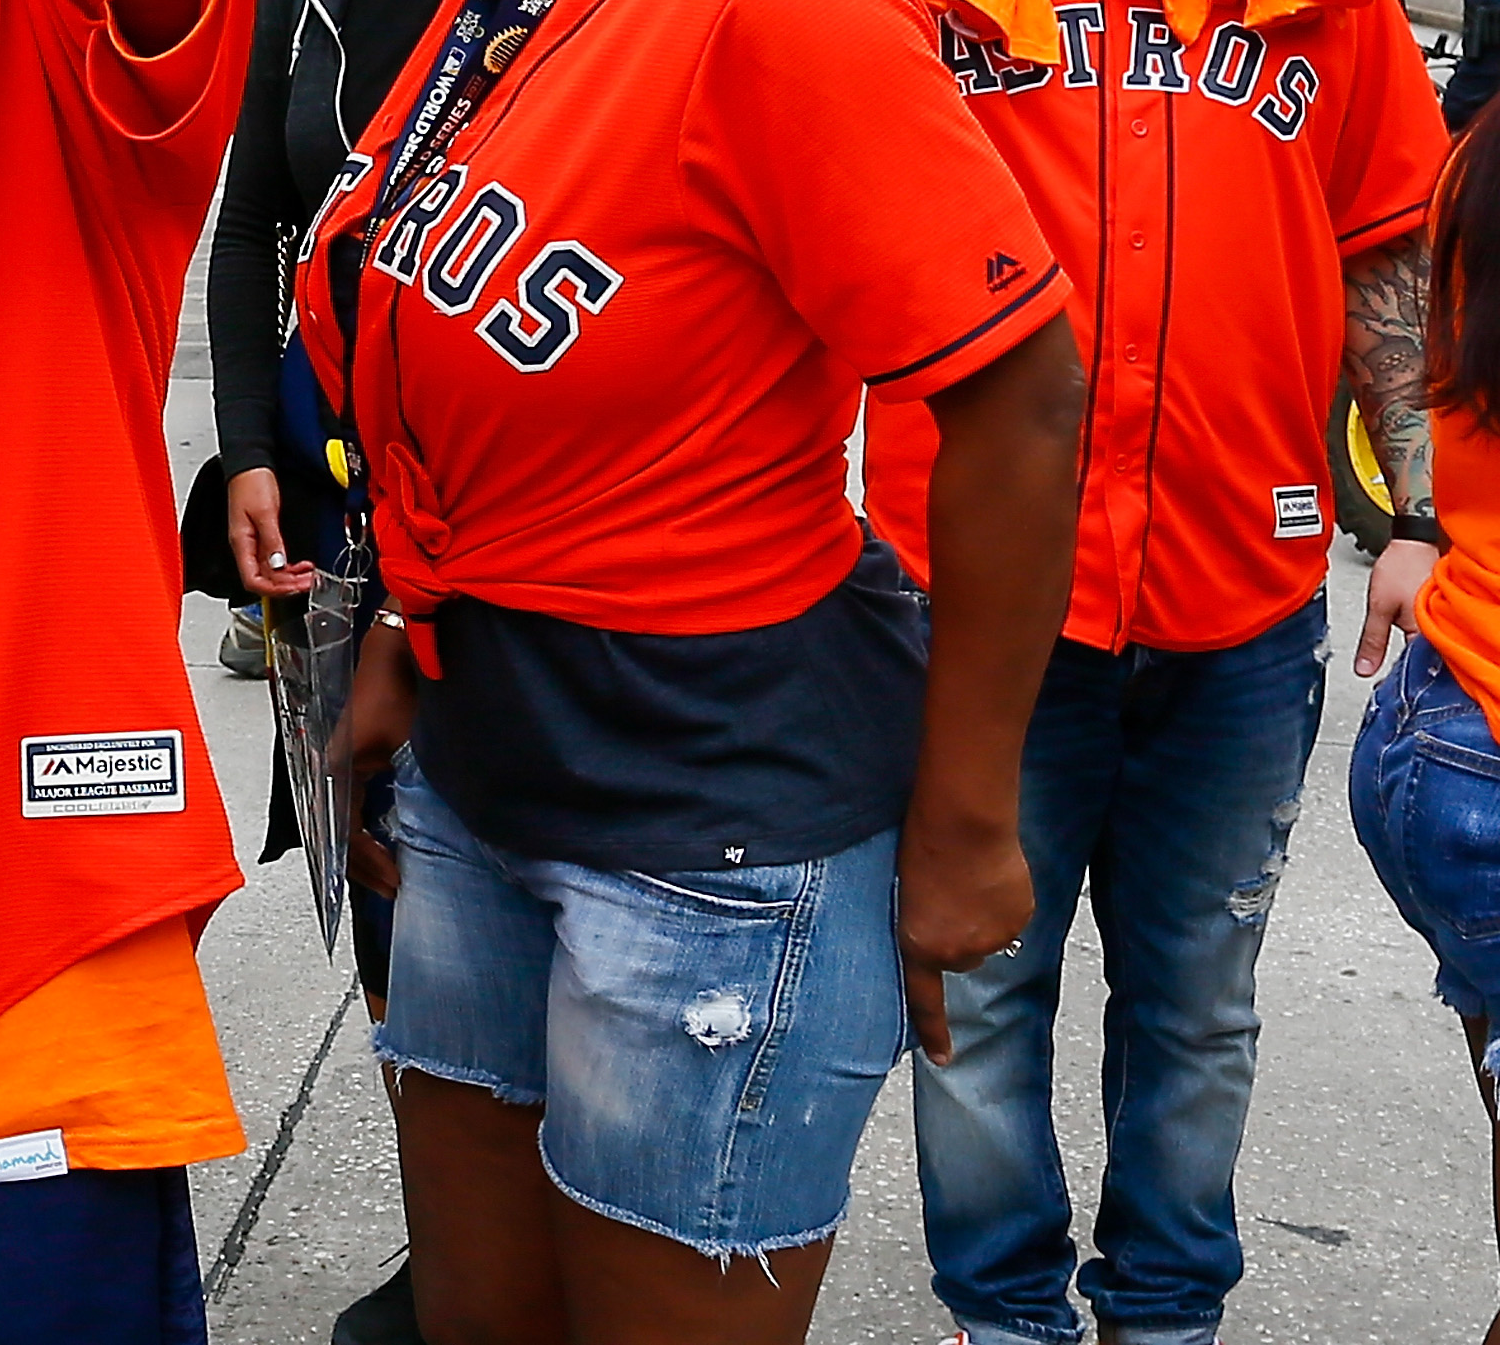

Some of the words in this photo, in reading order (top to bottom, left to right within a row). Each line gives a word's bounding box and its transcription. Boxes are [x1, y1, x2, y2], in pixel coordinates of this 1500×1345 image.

[415, 75, 457, 137] WORLD
[429, 97, 472, 151] SERIES
[76, 754, 164, 779] Majestic
[34, 787, 73, 800] MAJOR
[73, 784, 118, 798] LEAGUE
